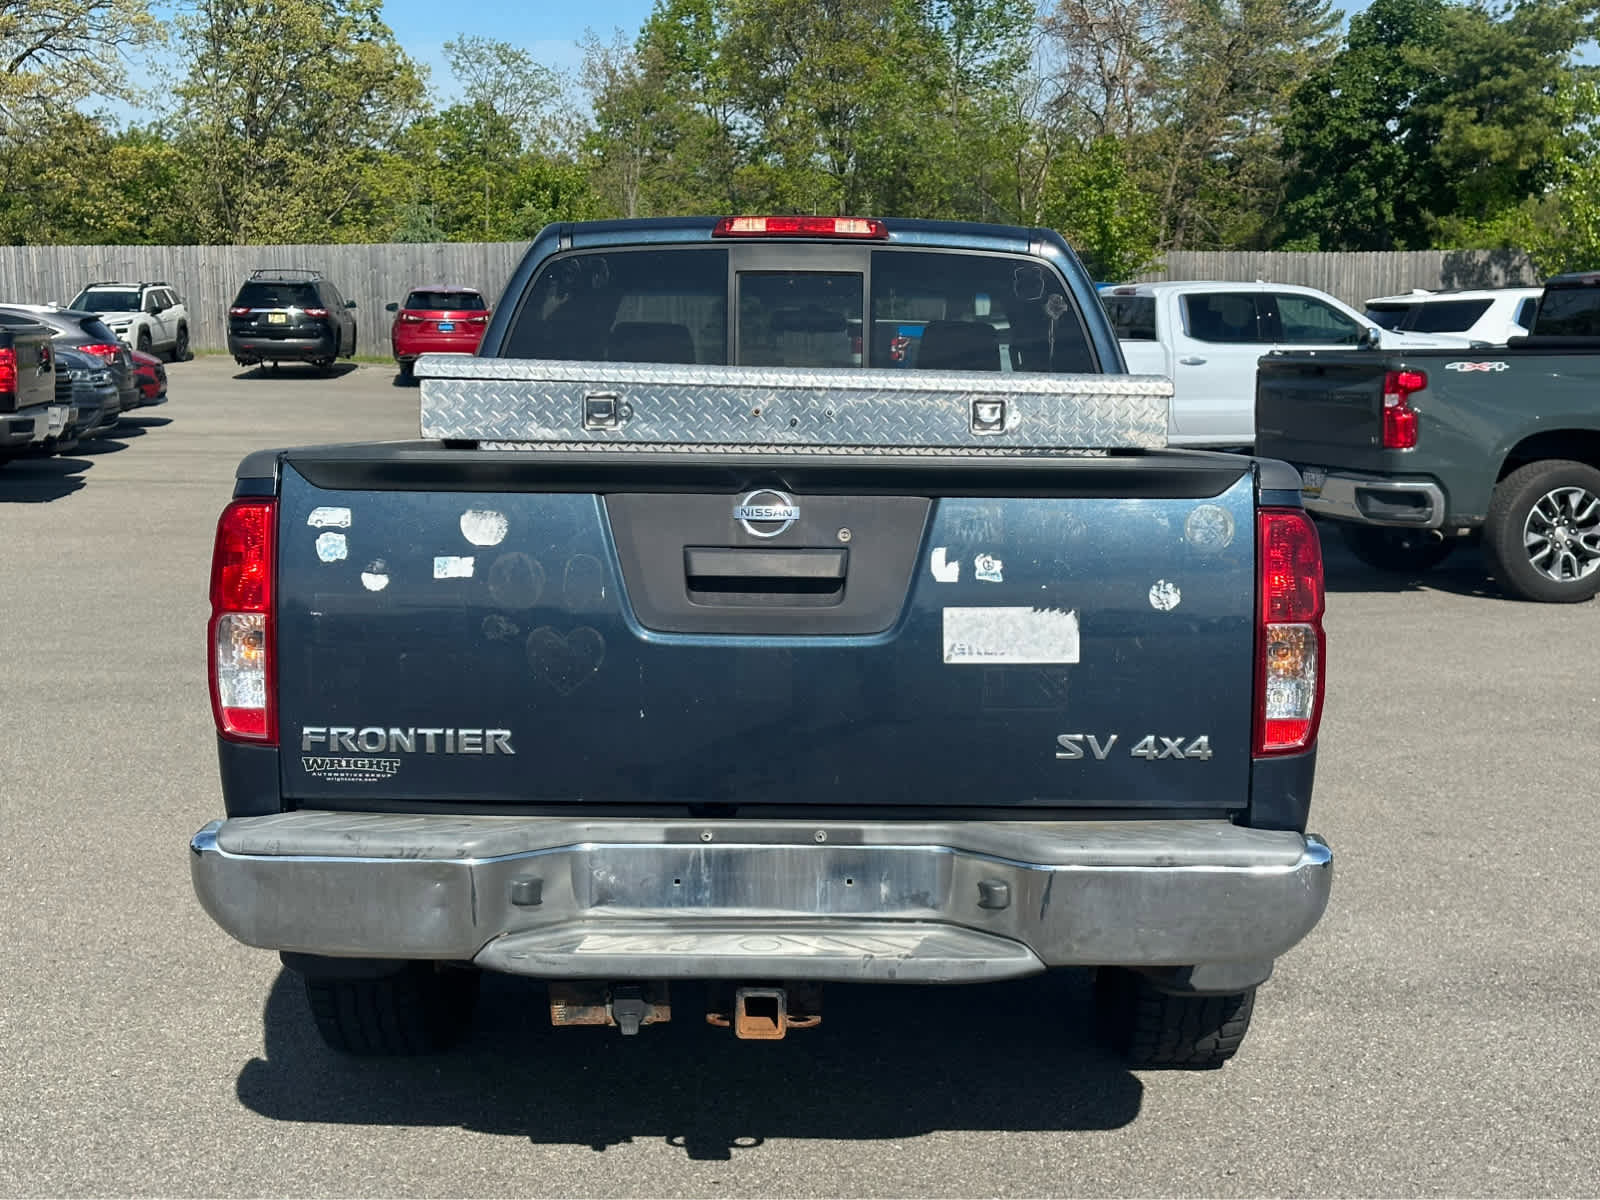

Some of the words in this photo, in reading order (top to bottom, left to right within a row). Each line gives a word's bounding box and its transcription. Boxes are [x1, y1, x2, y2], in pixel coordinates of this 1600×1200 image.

[740, 508, 793, 517] NISSAN
[302, 726, 516, 755] FRONTIER
[1055, 734, 1119, 760] SV
[302, 756, 401, 773] WRIGHT
